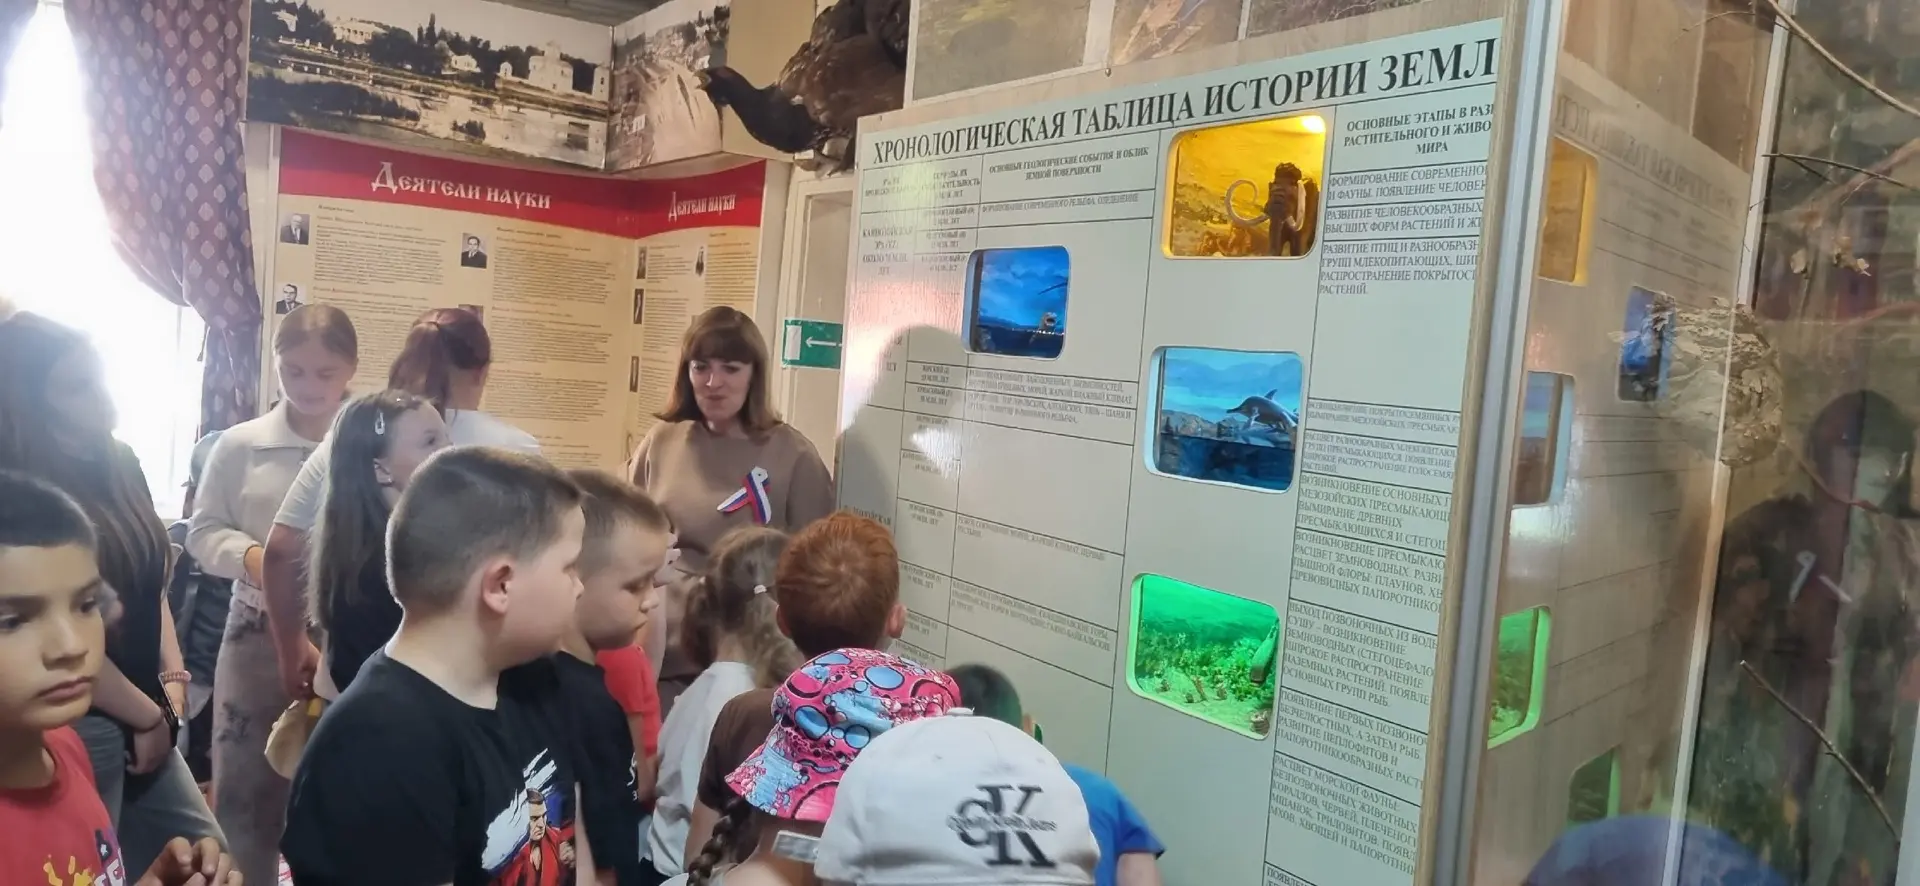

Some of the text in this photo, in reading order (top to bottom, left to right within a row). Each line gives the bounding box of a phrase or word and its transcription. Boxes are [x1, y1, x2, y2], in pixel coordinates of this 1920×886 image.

[873, 37, 1498, 164] ХРОНОЛОГИЧЕСКАЯ ТАБЛИЦА ИСТОРИИ ЗЕМЛ
[1347, 114, 1410, 132] ОСНОВНЫЕ
[1415, 108, 1456, 124] ЭТАПЫ
[1459, 107, 1467, 118] В
[1343, 120, 1491, 147] РАСТИТЕЛЬНОГО И ЖИВО
[1023, 155, 1078, 169] ГЕОЛОГИЧЕСКИЕ
[1079, 150, 1114, 163] СОБЫТИЯ
[1123, 147, 1149, 158] ОБЛИК
[1416, 141, 1448, 155] МИРА
[1052, 165, 1102, 178] ПОВЕРХНОСТИ
[1329, 165, 1488, 187] ФОРМИРОВАНИЕ СОВРЕМЕННО
[1376, 183, 1436, 198] ПОЯВЛЕНИЕ
[1326, 201, 1483, 221] РАЗВИТИЕ ЧЕЛОВЕКООБРАЗНЫХ
[1325, 221, 1369, 234] ВЫСШИХ
[1370, 219, 1399, 232] ФОРМ
[1401, 217, 1455, 230] РАСТЕНИЙ
[1457, 217, 1465, 229] И
[1323, 241, 1369, 254] РАЗВИТИЕ
[1370, 240, 1399, 254] ПТИЦ
[1400, 241, 1408, 252] И
[1320, 269, 1411, 281] РАСПРОСТРАНЕНИЕ
[1321, 256, 1352, 268] ГРУПП
[1299, 474, 1381, 497] ВОЗНИКНОВЕНИЕ
[1383, 486, 1443, 506] ОСНОВНЫХ
[1298, 500, 1402, 528] ВЫМИРАНИЕ ДРЕВНИХ
[1299, 487, 1450, 522] МЕЗОЗОЙСКИХ ПРЕСМЫКАЮЩ
[1297, 513, 1394, 540] ПРЕСМЫКАЮЩИХСЯ
[1395, 532, 1403, 543] И
[1294, 543, 1332, 560] РАСЦВЕТ
[1295, 530, 1375, 556] ВОЗНИКНОВЕНИЕ
[1293, 556, 1335, 572] ПЫШНОЙ
[1291, 570, 1441, 613] ДРЕВОВИДНЫХ ПАПОРОТНИКО
[1288, 615, 1314, 630] СУШУ
[1323, 624, 1407, 655] ВОЗНИКНОВЕНИЕ
[1289, 602, 1321, 619] ВЫХОД
[1321, 609, 1394, 638] ПОЗВОНОЧНЫХ
[1396, 630, 1409, 642] ИЗ
[1286, 627, 1356, 655] ЗЕМНОВОДНЫХ
[1283, 652, 1334, 678] НАЗЕМНЫХ
[1285, 640, 1424, 689] ШИРОКОЕ РАСПРОСТРАНЕНИЕ
[1283, 666, 1334, 691] ОСНОВНЫХ
[1335, 682, 1367, 699] ГРУПП
[1278, 715, 1321, 738] РАЗВИТИЕ
[1281, 690, 1427, 747] ПОЯВЛЕНИЕ ПЕРВЫХ ПОЗВОНО
[1277, 728, 1394, 779] ПАПОРОТНИКООБРАЗНЫХ
[1356, 729, 1365, 739] А
[1366, 731, 1397, 752] ЗАТЕМ
[1274, 755, 1312, 778] РАСЦВЕТ
[1314, 769, 1359, 796] МОРСКОЙ
[1273, 768, 1417, 833] БЕЗПОЗВОНОЧНЫХ ЖИВОТНЫХ
[1299, 817, 1339, 842] ХВОЩЕЙ
